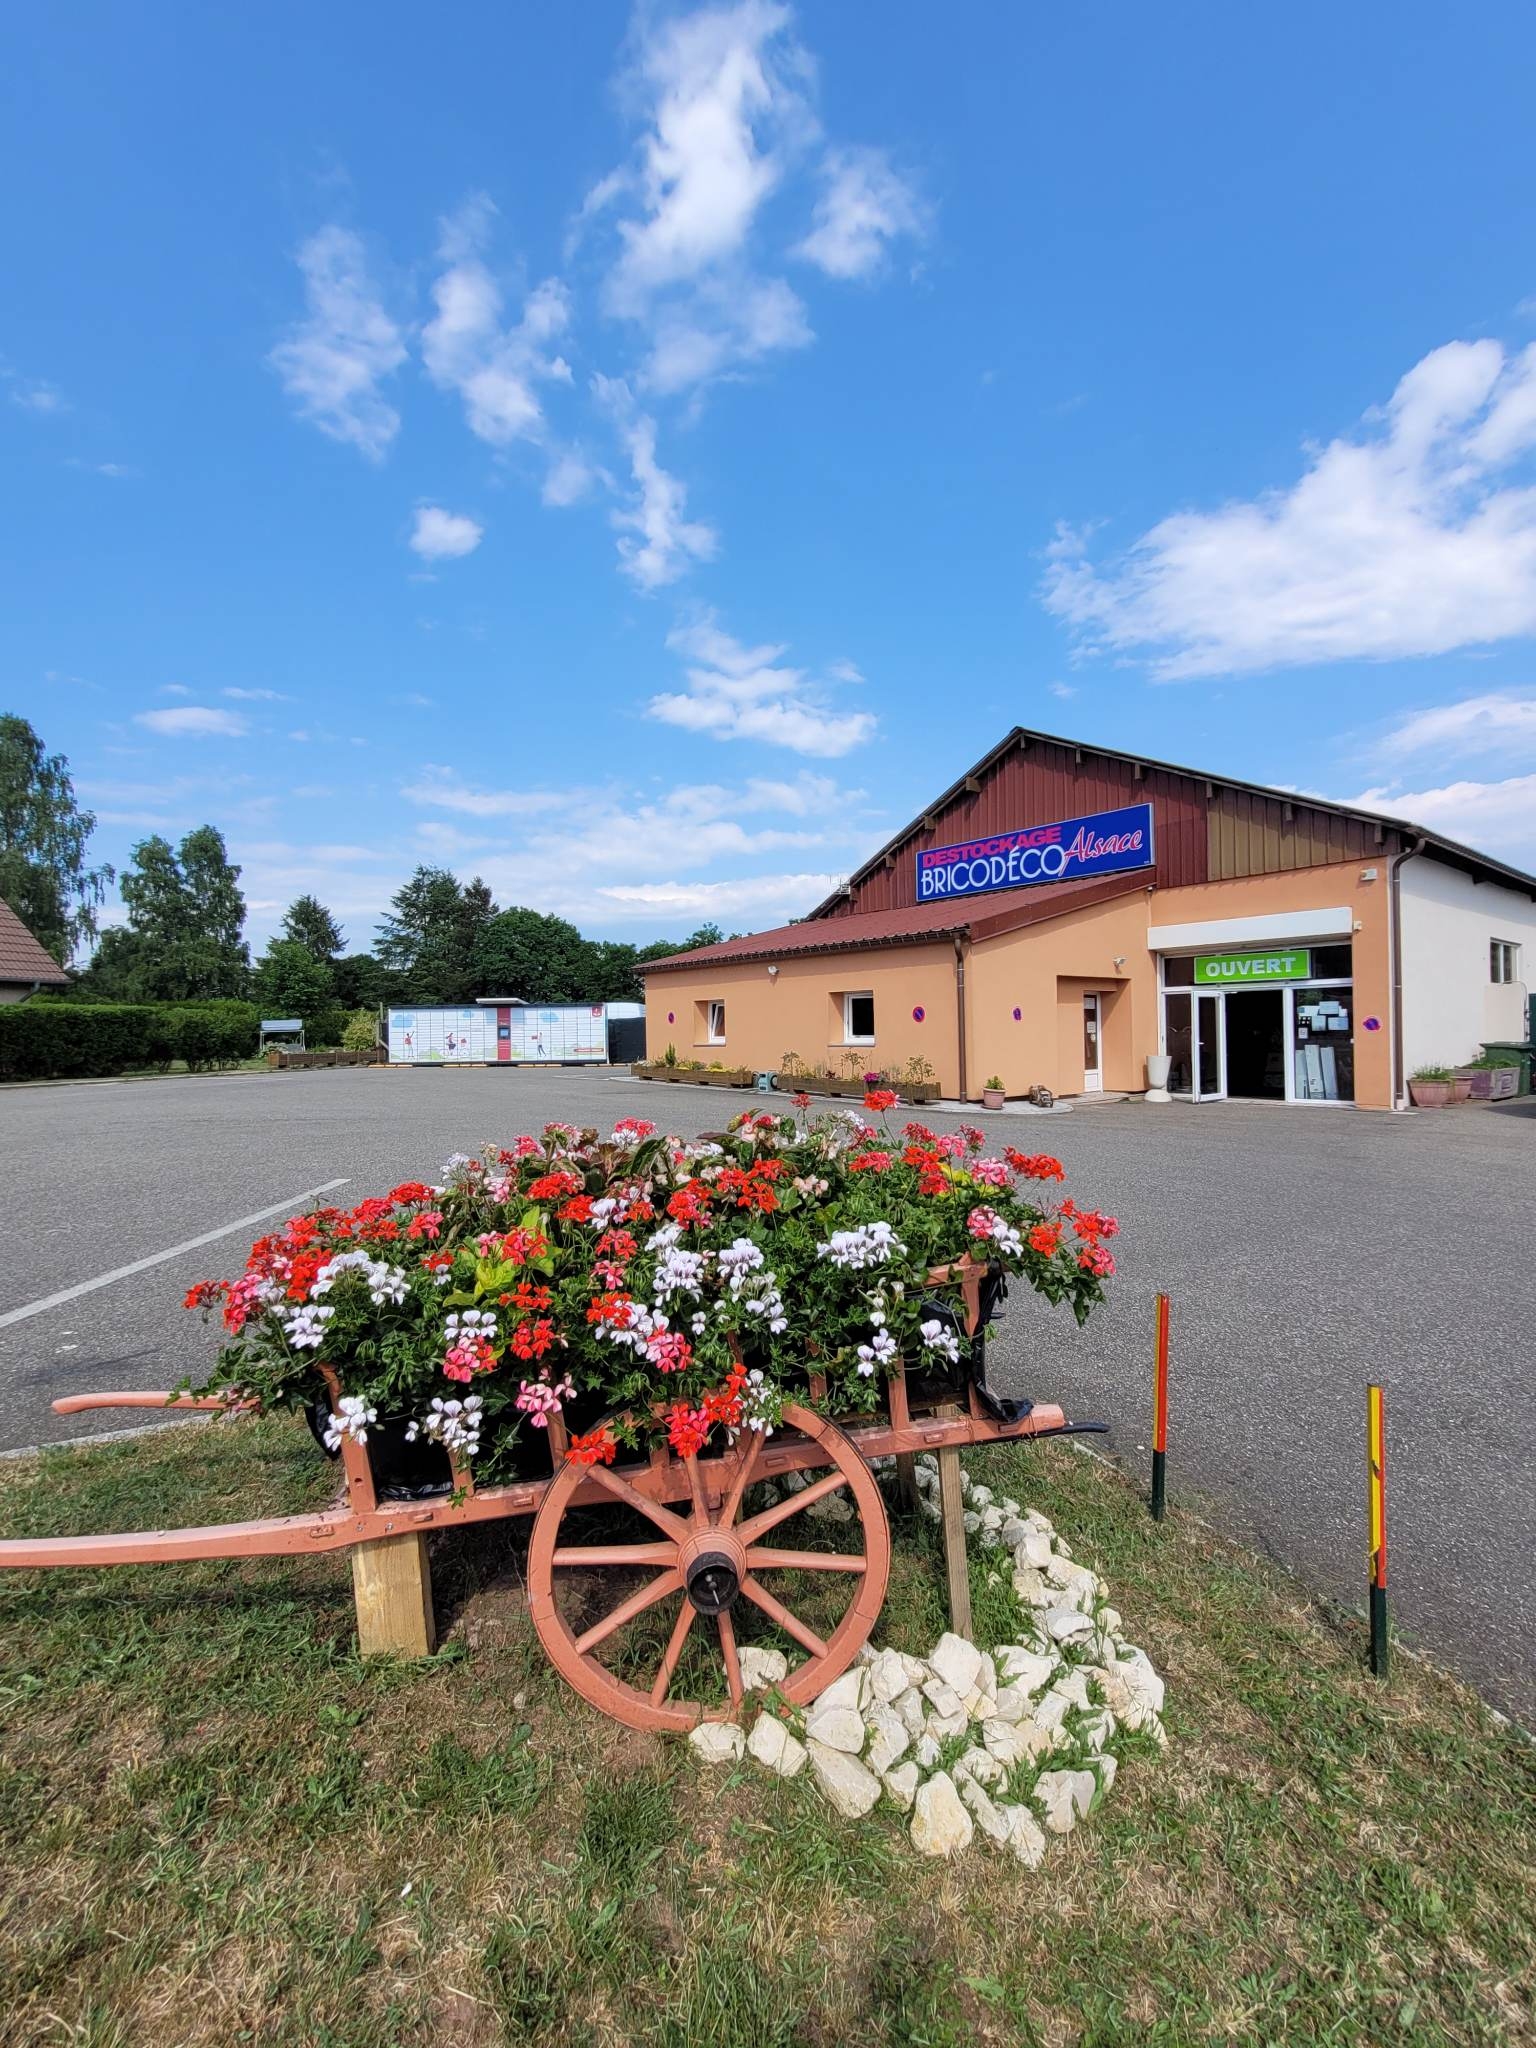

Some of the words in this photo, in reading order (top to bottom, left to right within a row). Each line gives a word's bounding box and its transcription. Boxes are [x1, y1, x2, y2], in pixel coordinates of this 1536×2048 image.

[921, 845, 1065, 895] BRICODÉCO
[1058, 826, 1143, 876] Alsace
[923, 826, 1061, 867] DESTOCKAGE
[1205, 958, 1296, 977] OUVERT
